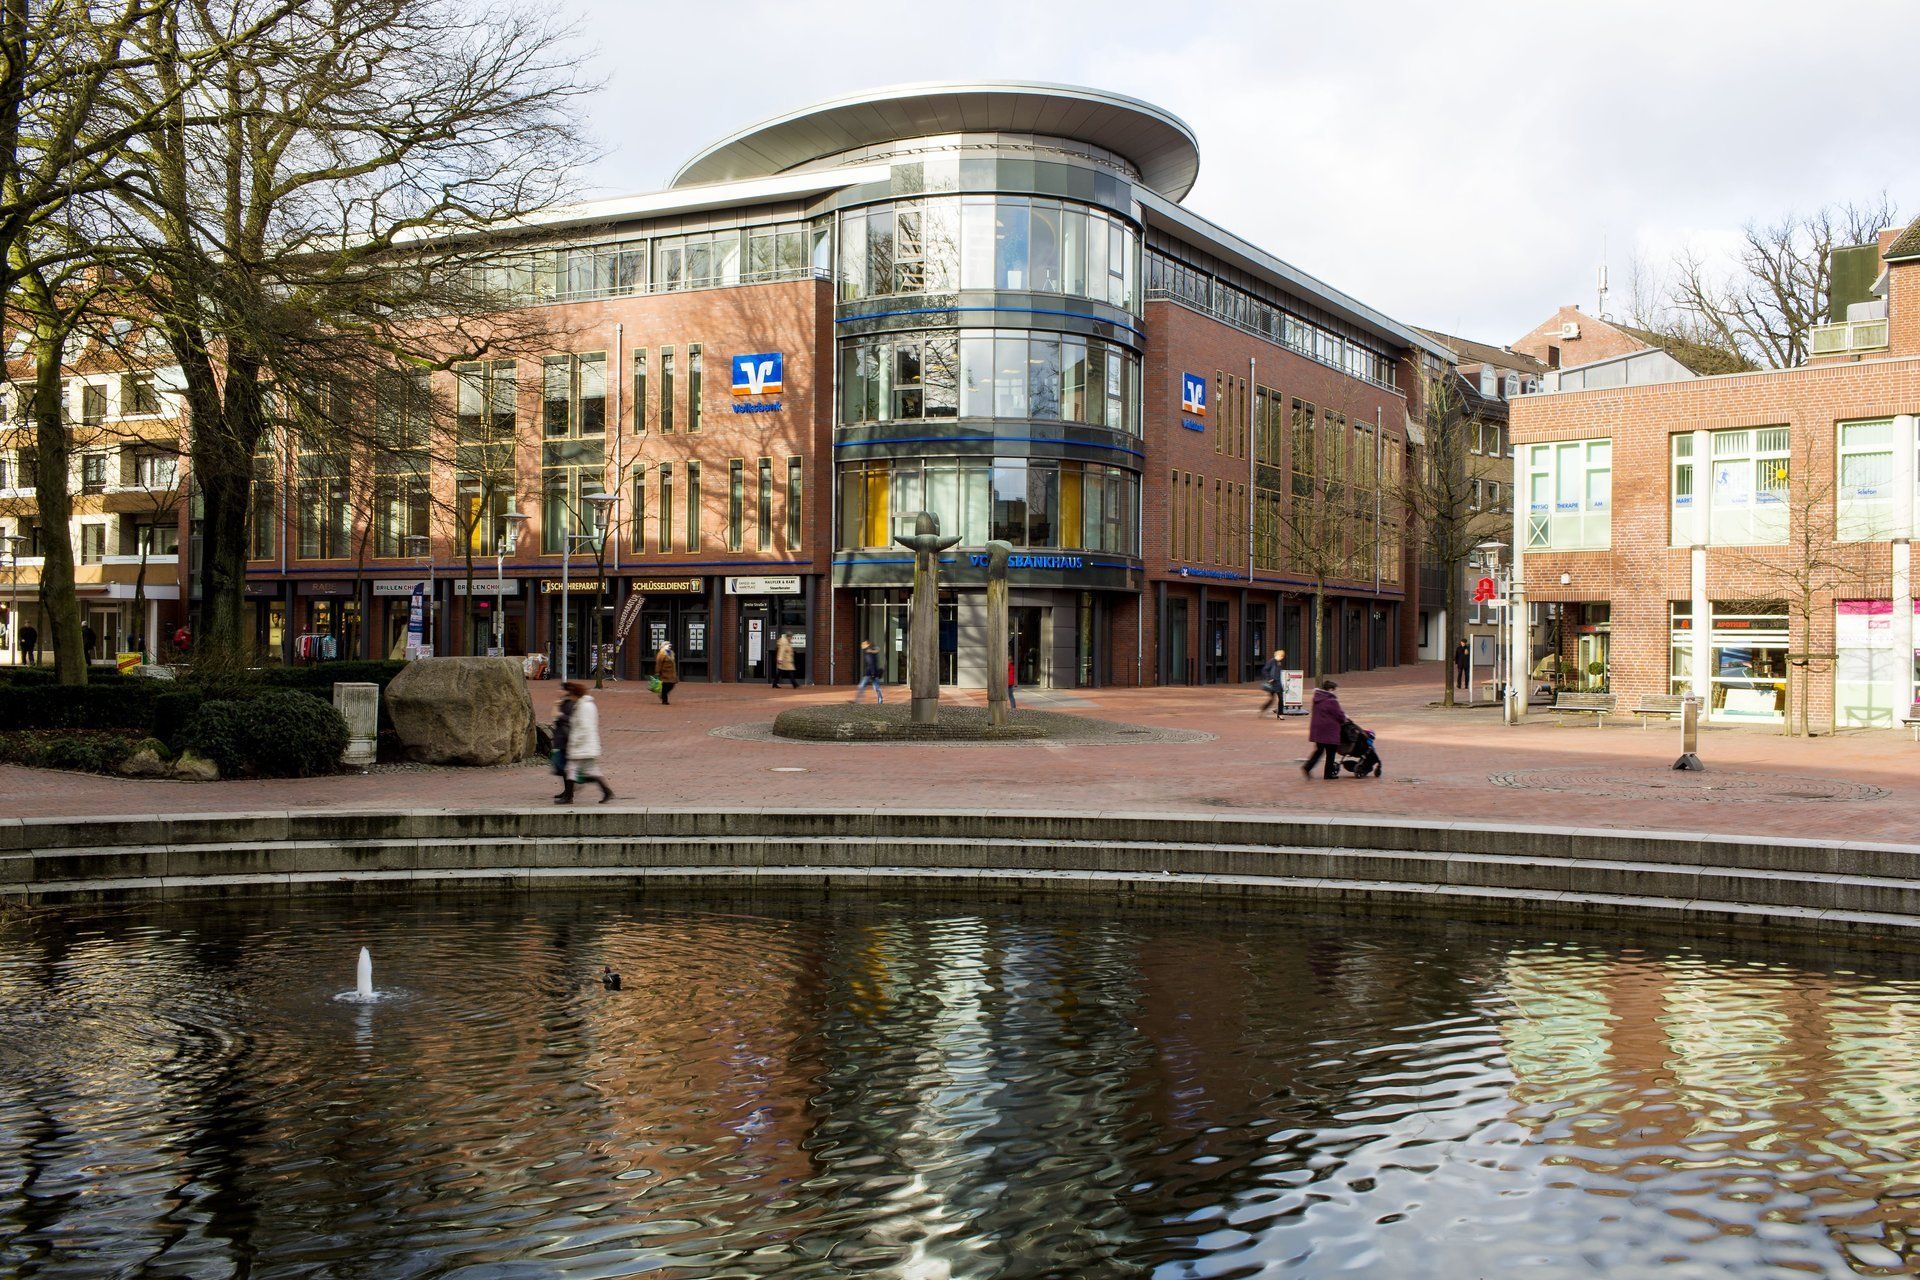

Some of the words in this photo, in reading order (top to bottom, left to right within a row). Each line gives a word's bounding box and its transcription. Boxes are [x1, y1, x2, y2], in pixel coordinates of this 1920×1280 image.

[732, 401, 783, 414] Volksbank
[551, 582, 606, 591] SCHHREPARATR
[632, 580, 690, 591] SCHLÜSSELDIENST
